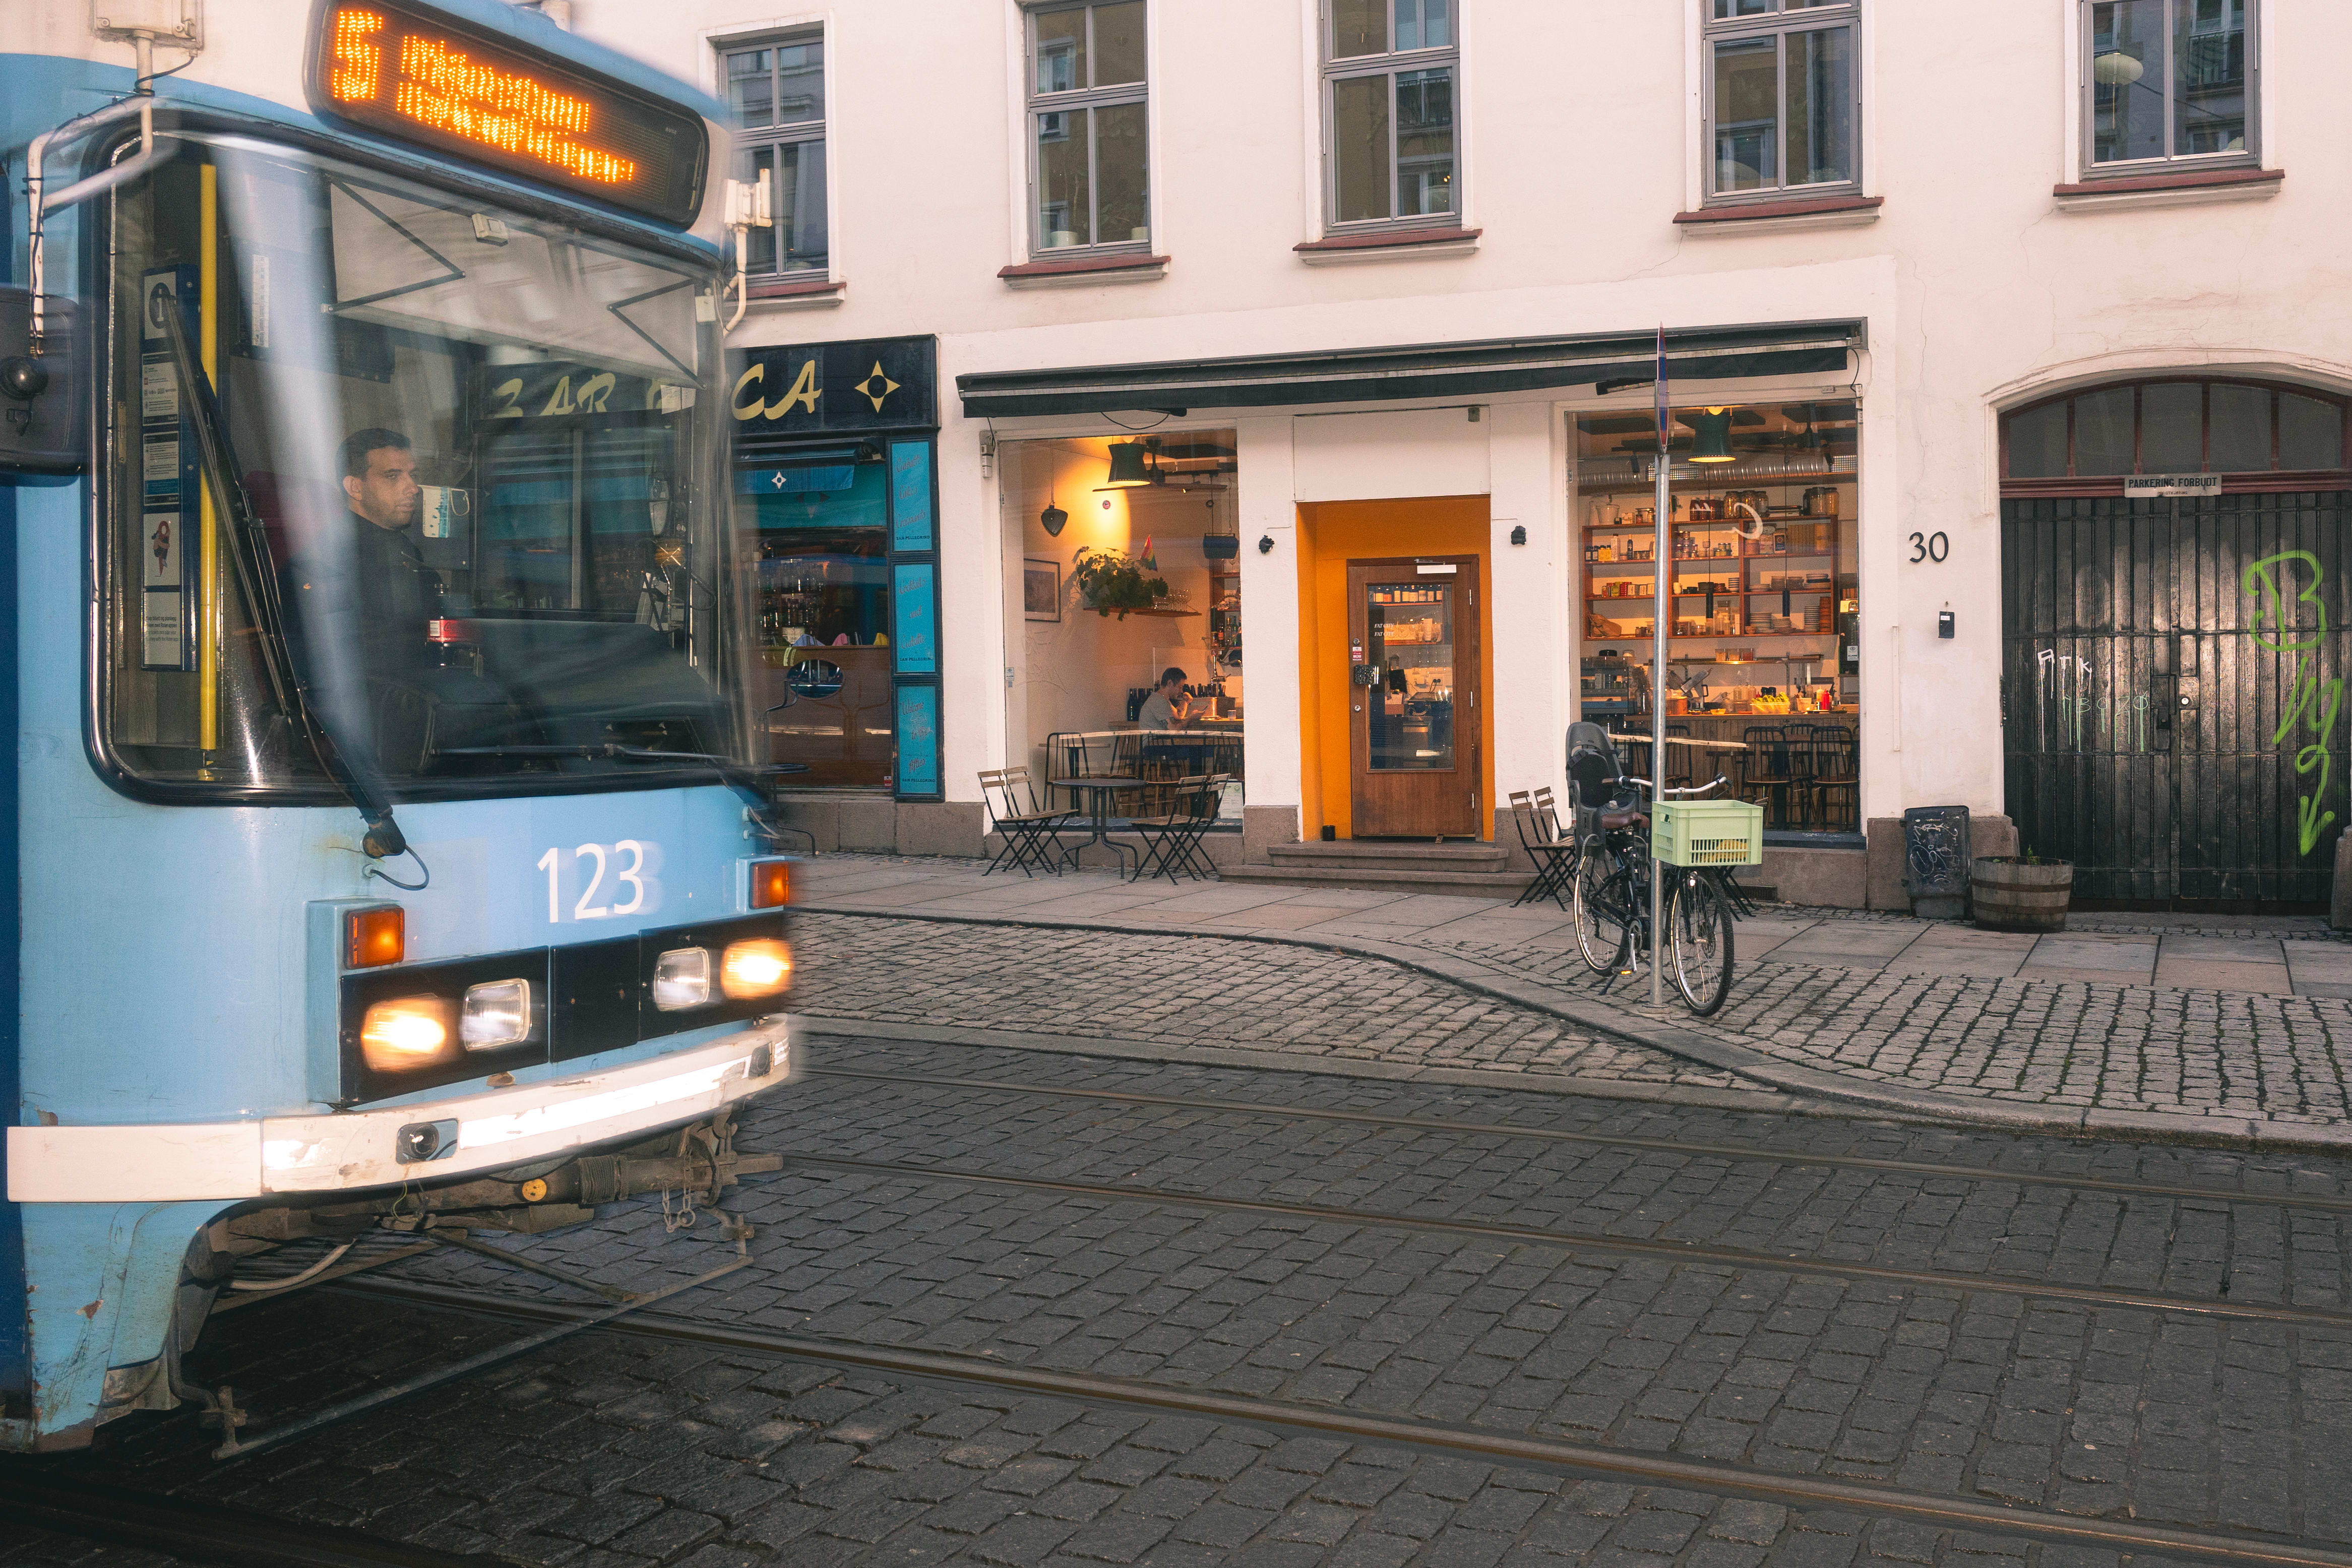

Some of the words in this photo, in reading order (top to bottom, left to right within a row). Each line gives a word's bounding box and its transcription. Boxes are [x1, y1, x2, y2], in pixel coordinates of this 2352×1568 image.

[2129, 478, 2174, 488] PARKERING
[2178, 477, 2217, 487] FORBUDT
[1909, 531, 1949, 563] 30
[909, 605, 922, 618] and
[537, 839, 644, 923] 123
